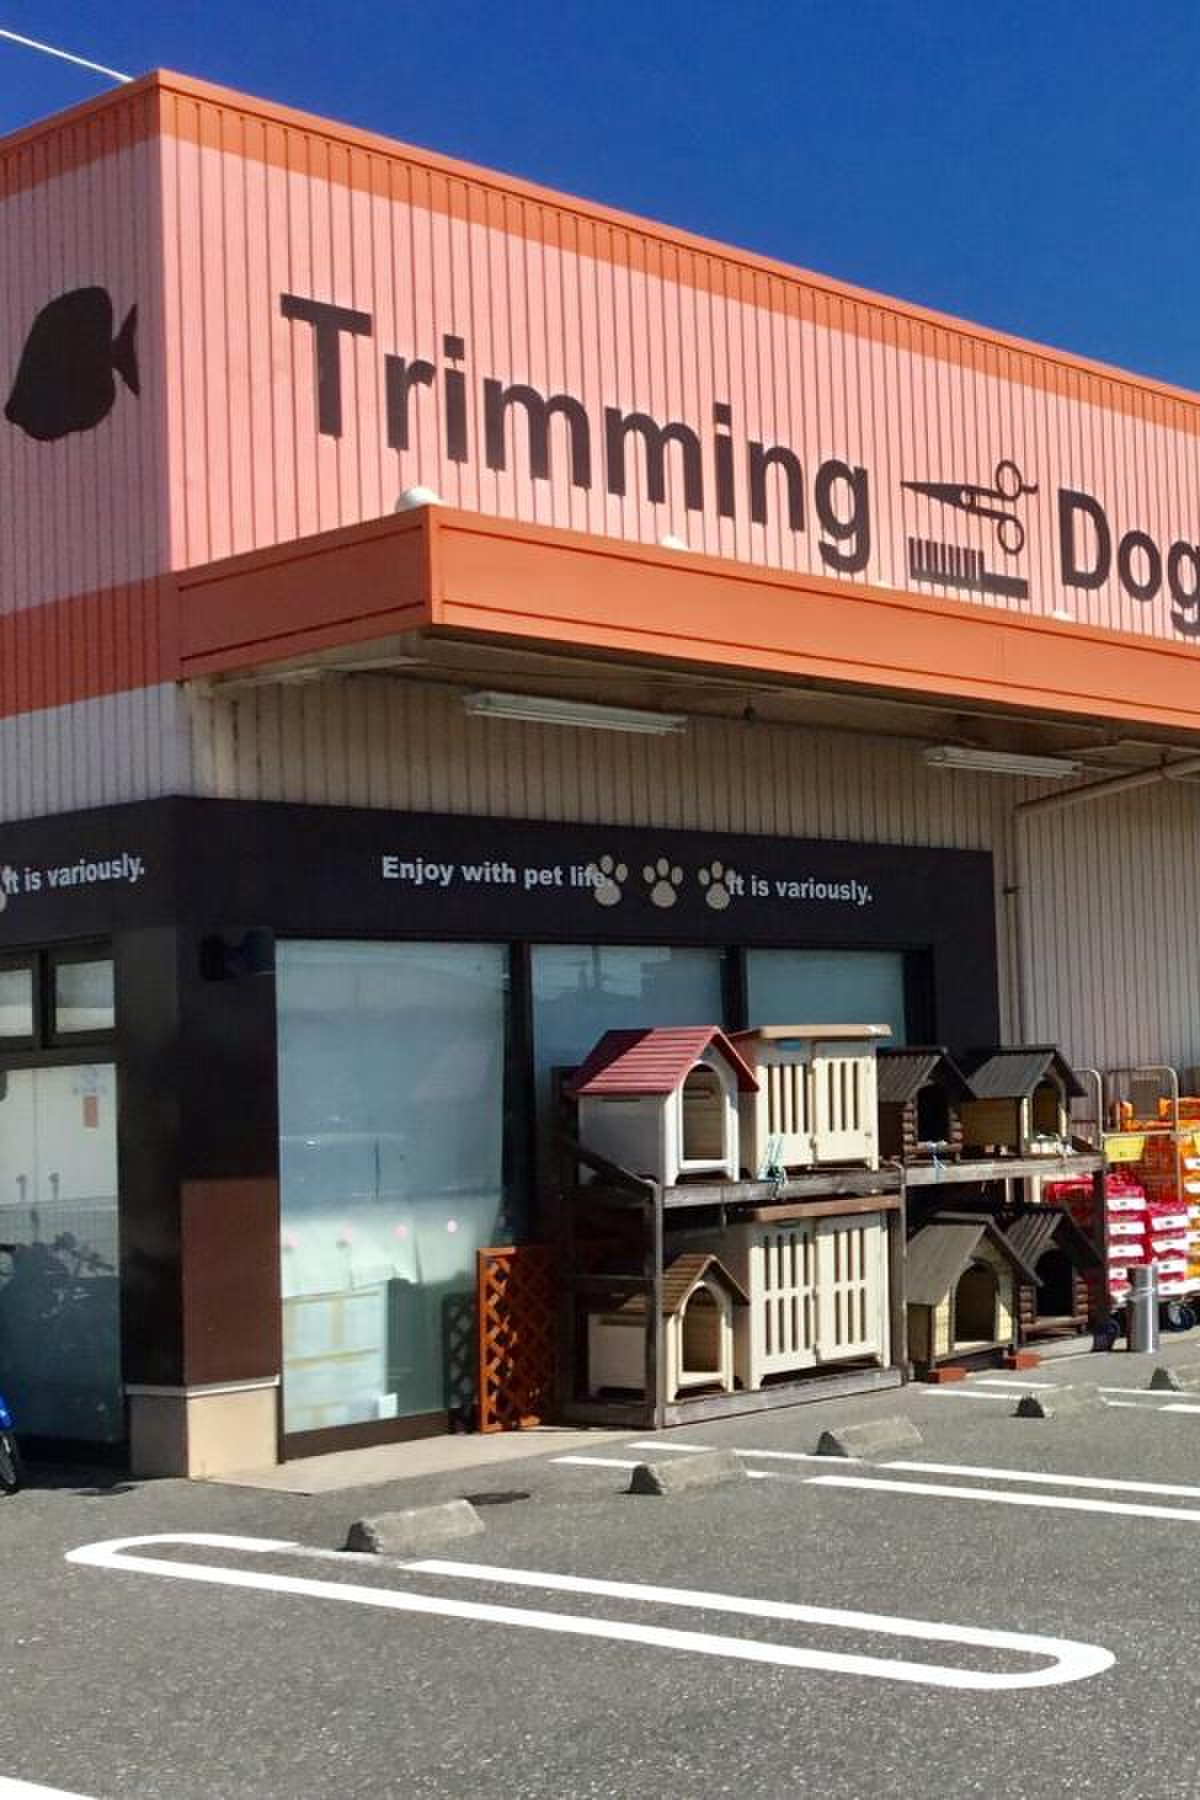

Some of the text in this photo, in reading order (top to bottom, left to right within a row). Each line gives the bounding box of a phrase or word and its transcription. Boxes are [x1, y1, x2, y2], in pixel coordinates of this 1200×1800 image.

[280, 293, 871, 573] Trimming
[24, 866, 41, 892] is
[48, 852, 145, 887] variously.
[383, 855, 454, 887] Enjoy
[461, 861, 516, 883] with
[524, 866, 563, 890] pet
[751, 874, 769, 896] is
[775, 877, 873, 906] variously.
